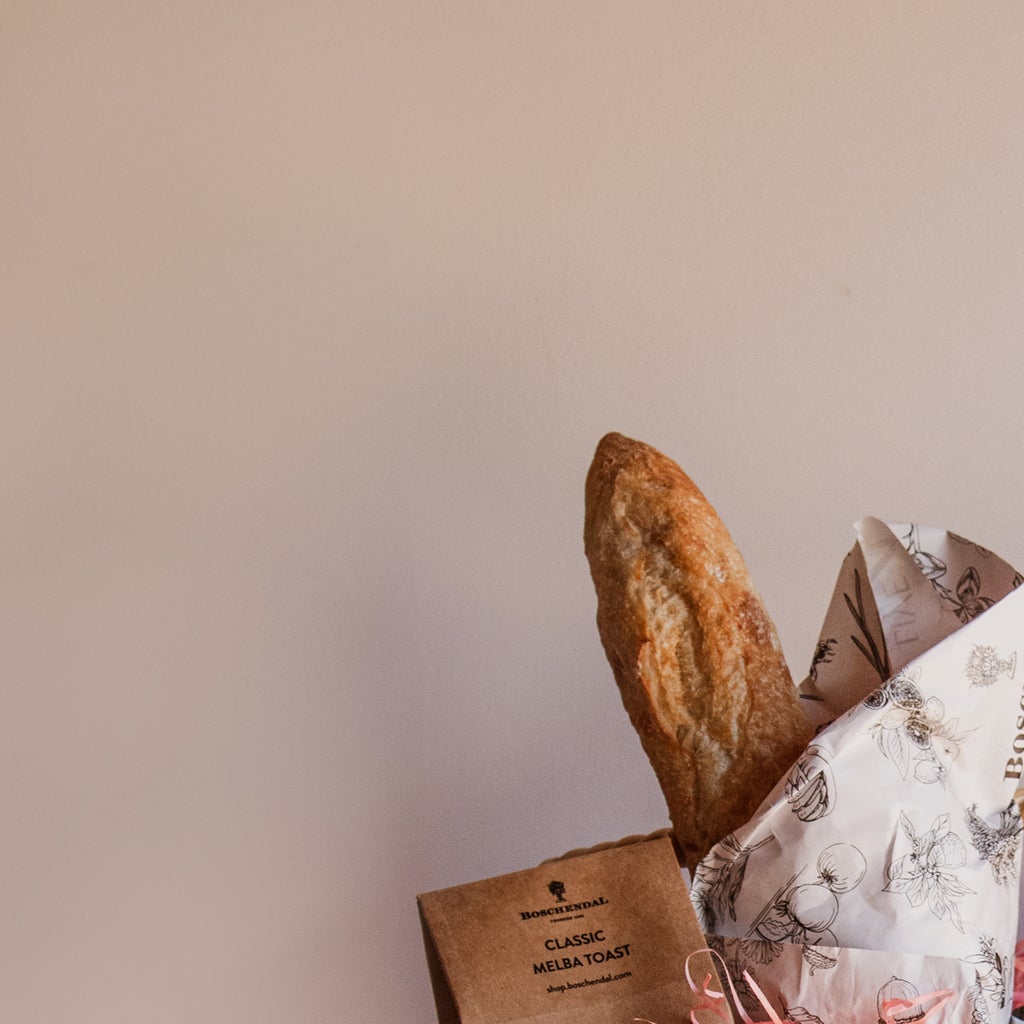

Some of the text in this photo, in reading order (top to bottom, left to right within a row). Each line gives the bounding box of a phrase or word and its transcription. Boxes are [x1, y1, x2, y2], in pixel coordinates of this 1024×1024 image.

[519, 897, 608, 920] BOSCHENDAL
[544, 930, 606, 951] CLASSIC
[533, 944, 631, 975] MELBA TOAST
[546, 971, 632, 993] shop.boschendal.com
